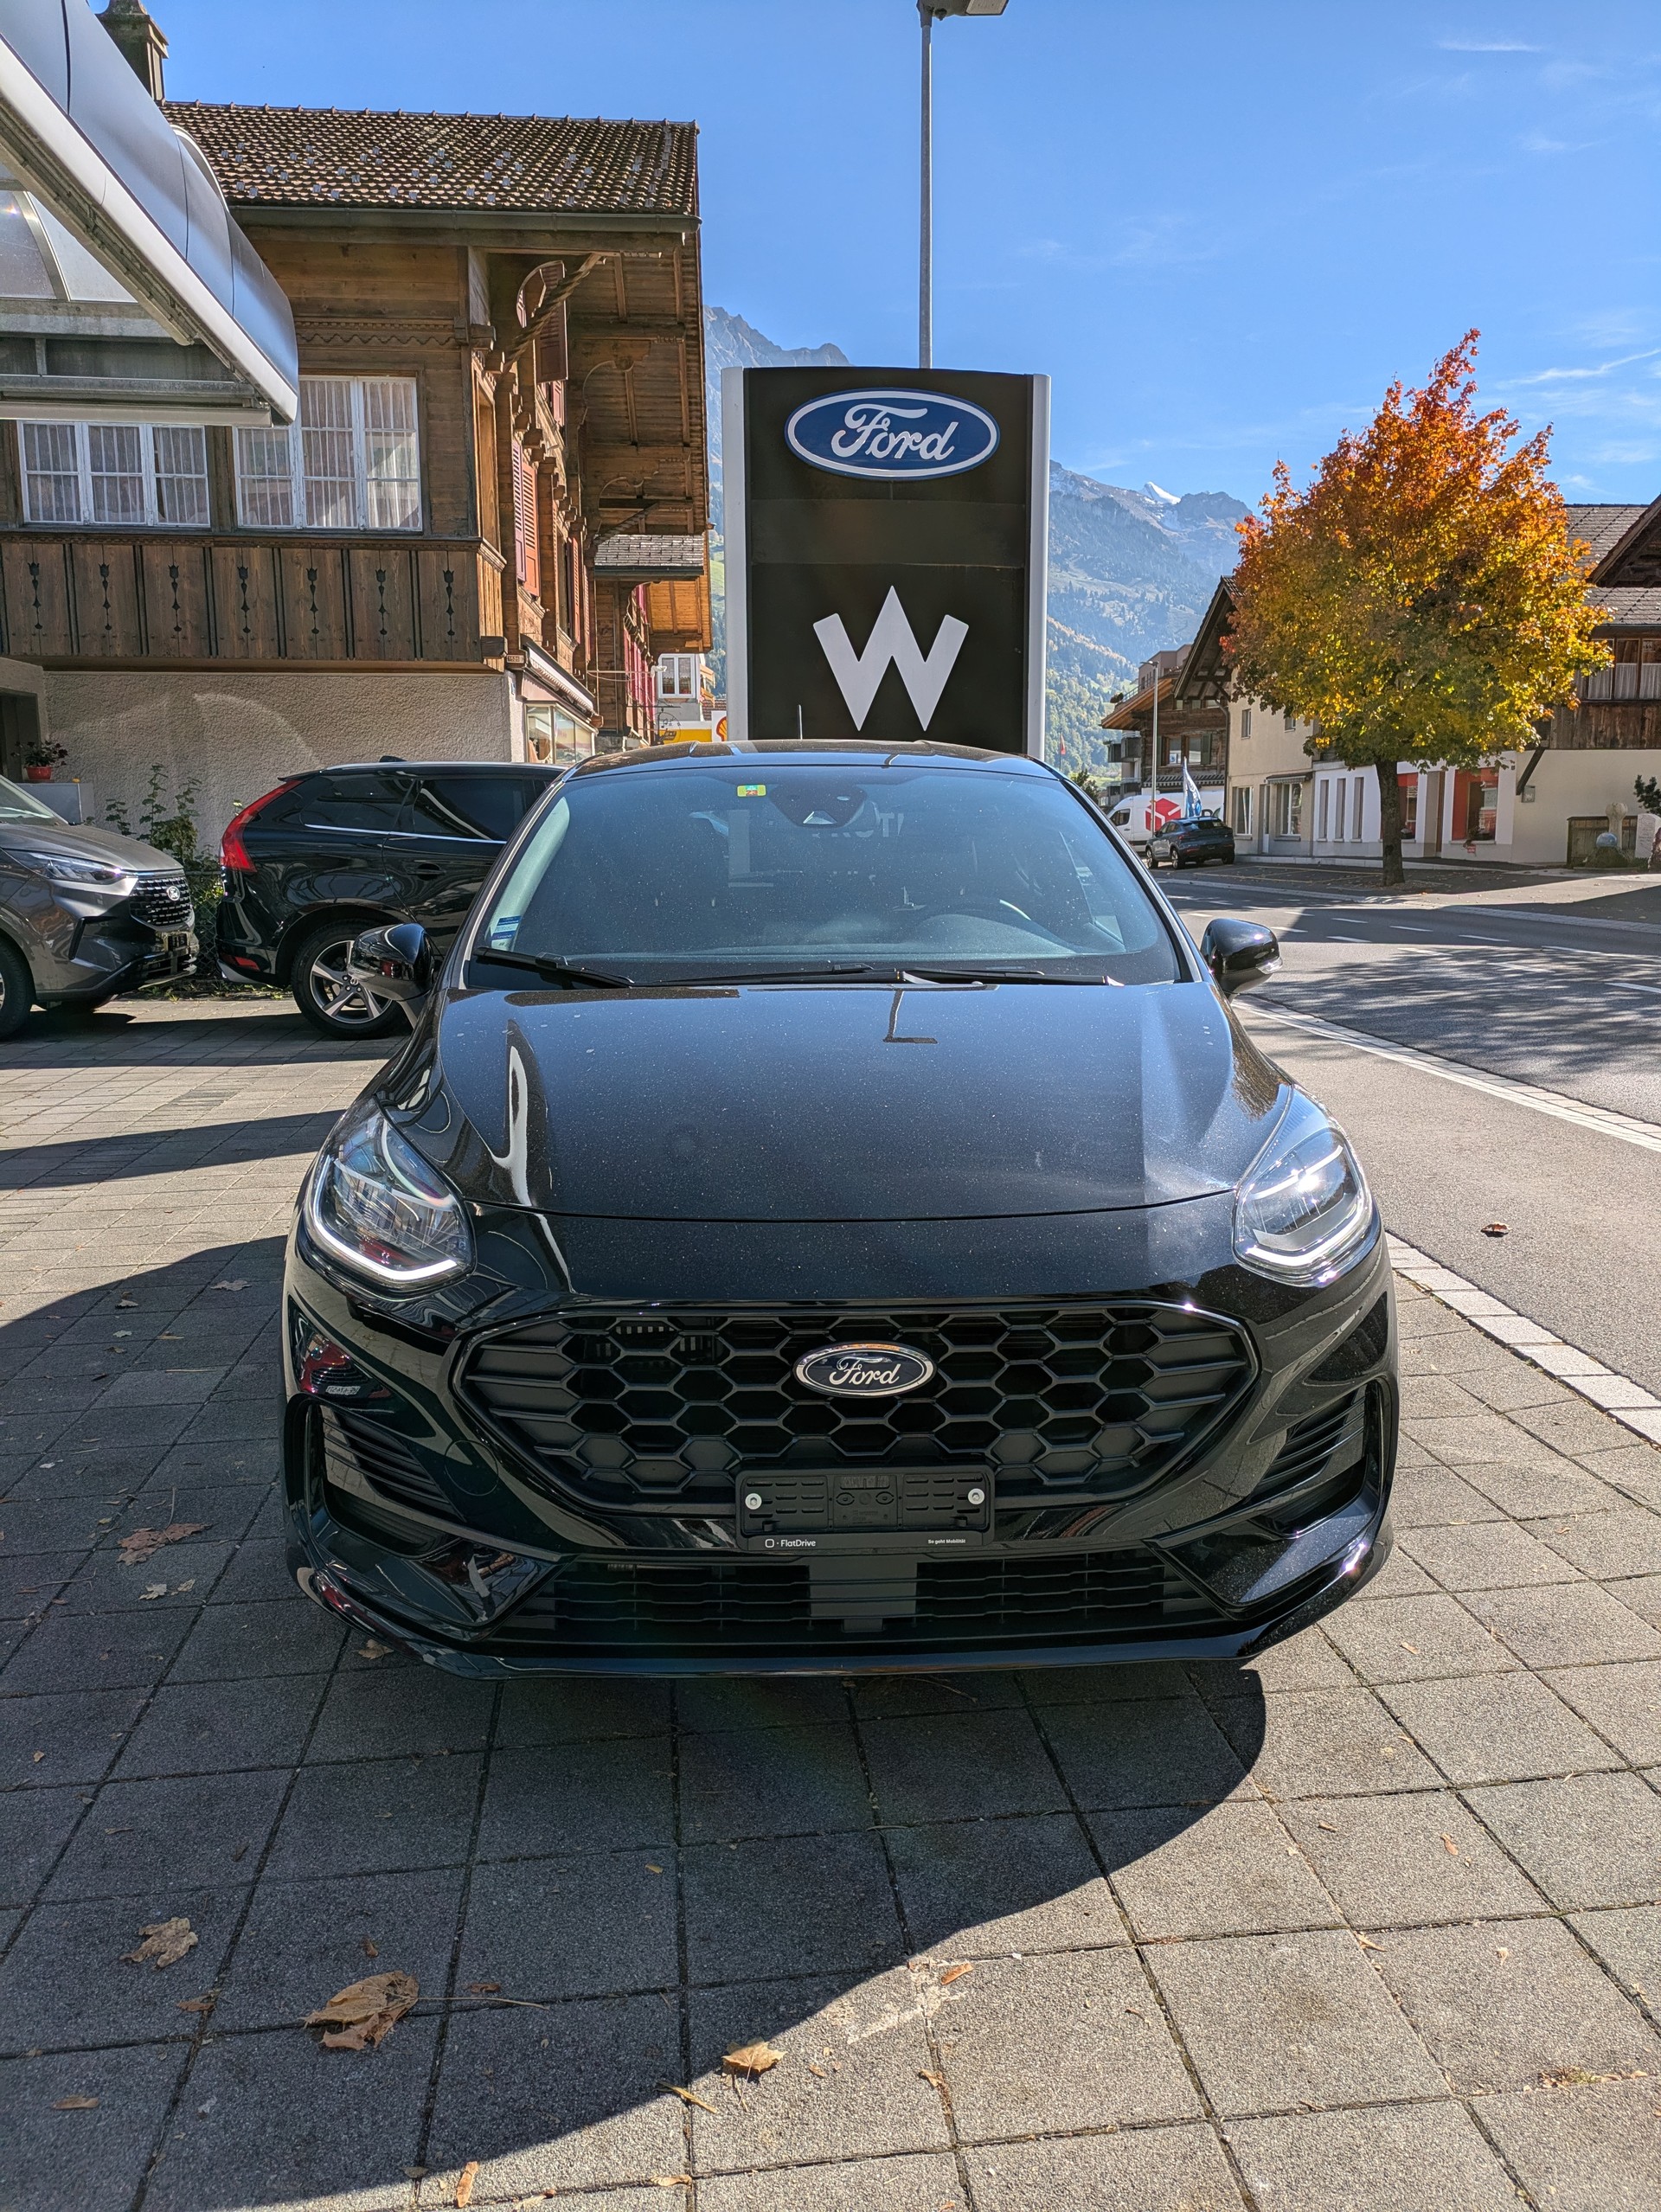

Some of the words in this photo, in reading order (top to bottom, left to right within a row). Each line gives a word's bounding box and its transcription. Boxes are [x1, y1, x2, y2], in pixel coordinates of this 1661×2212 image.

[830, 403, 959, 461] Ford
[812, 585, 969, 732] W
[829, 1356, 901, 1385] Ford
